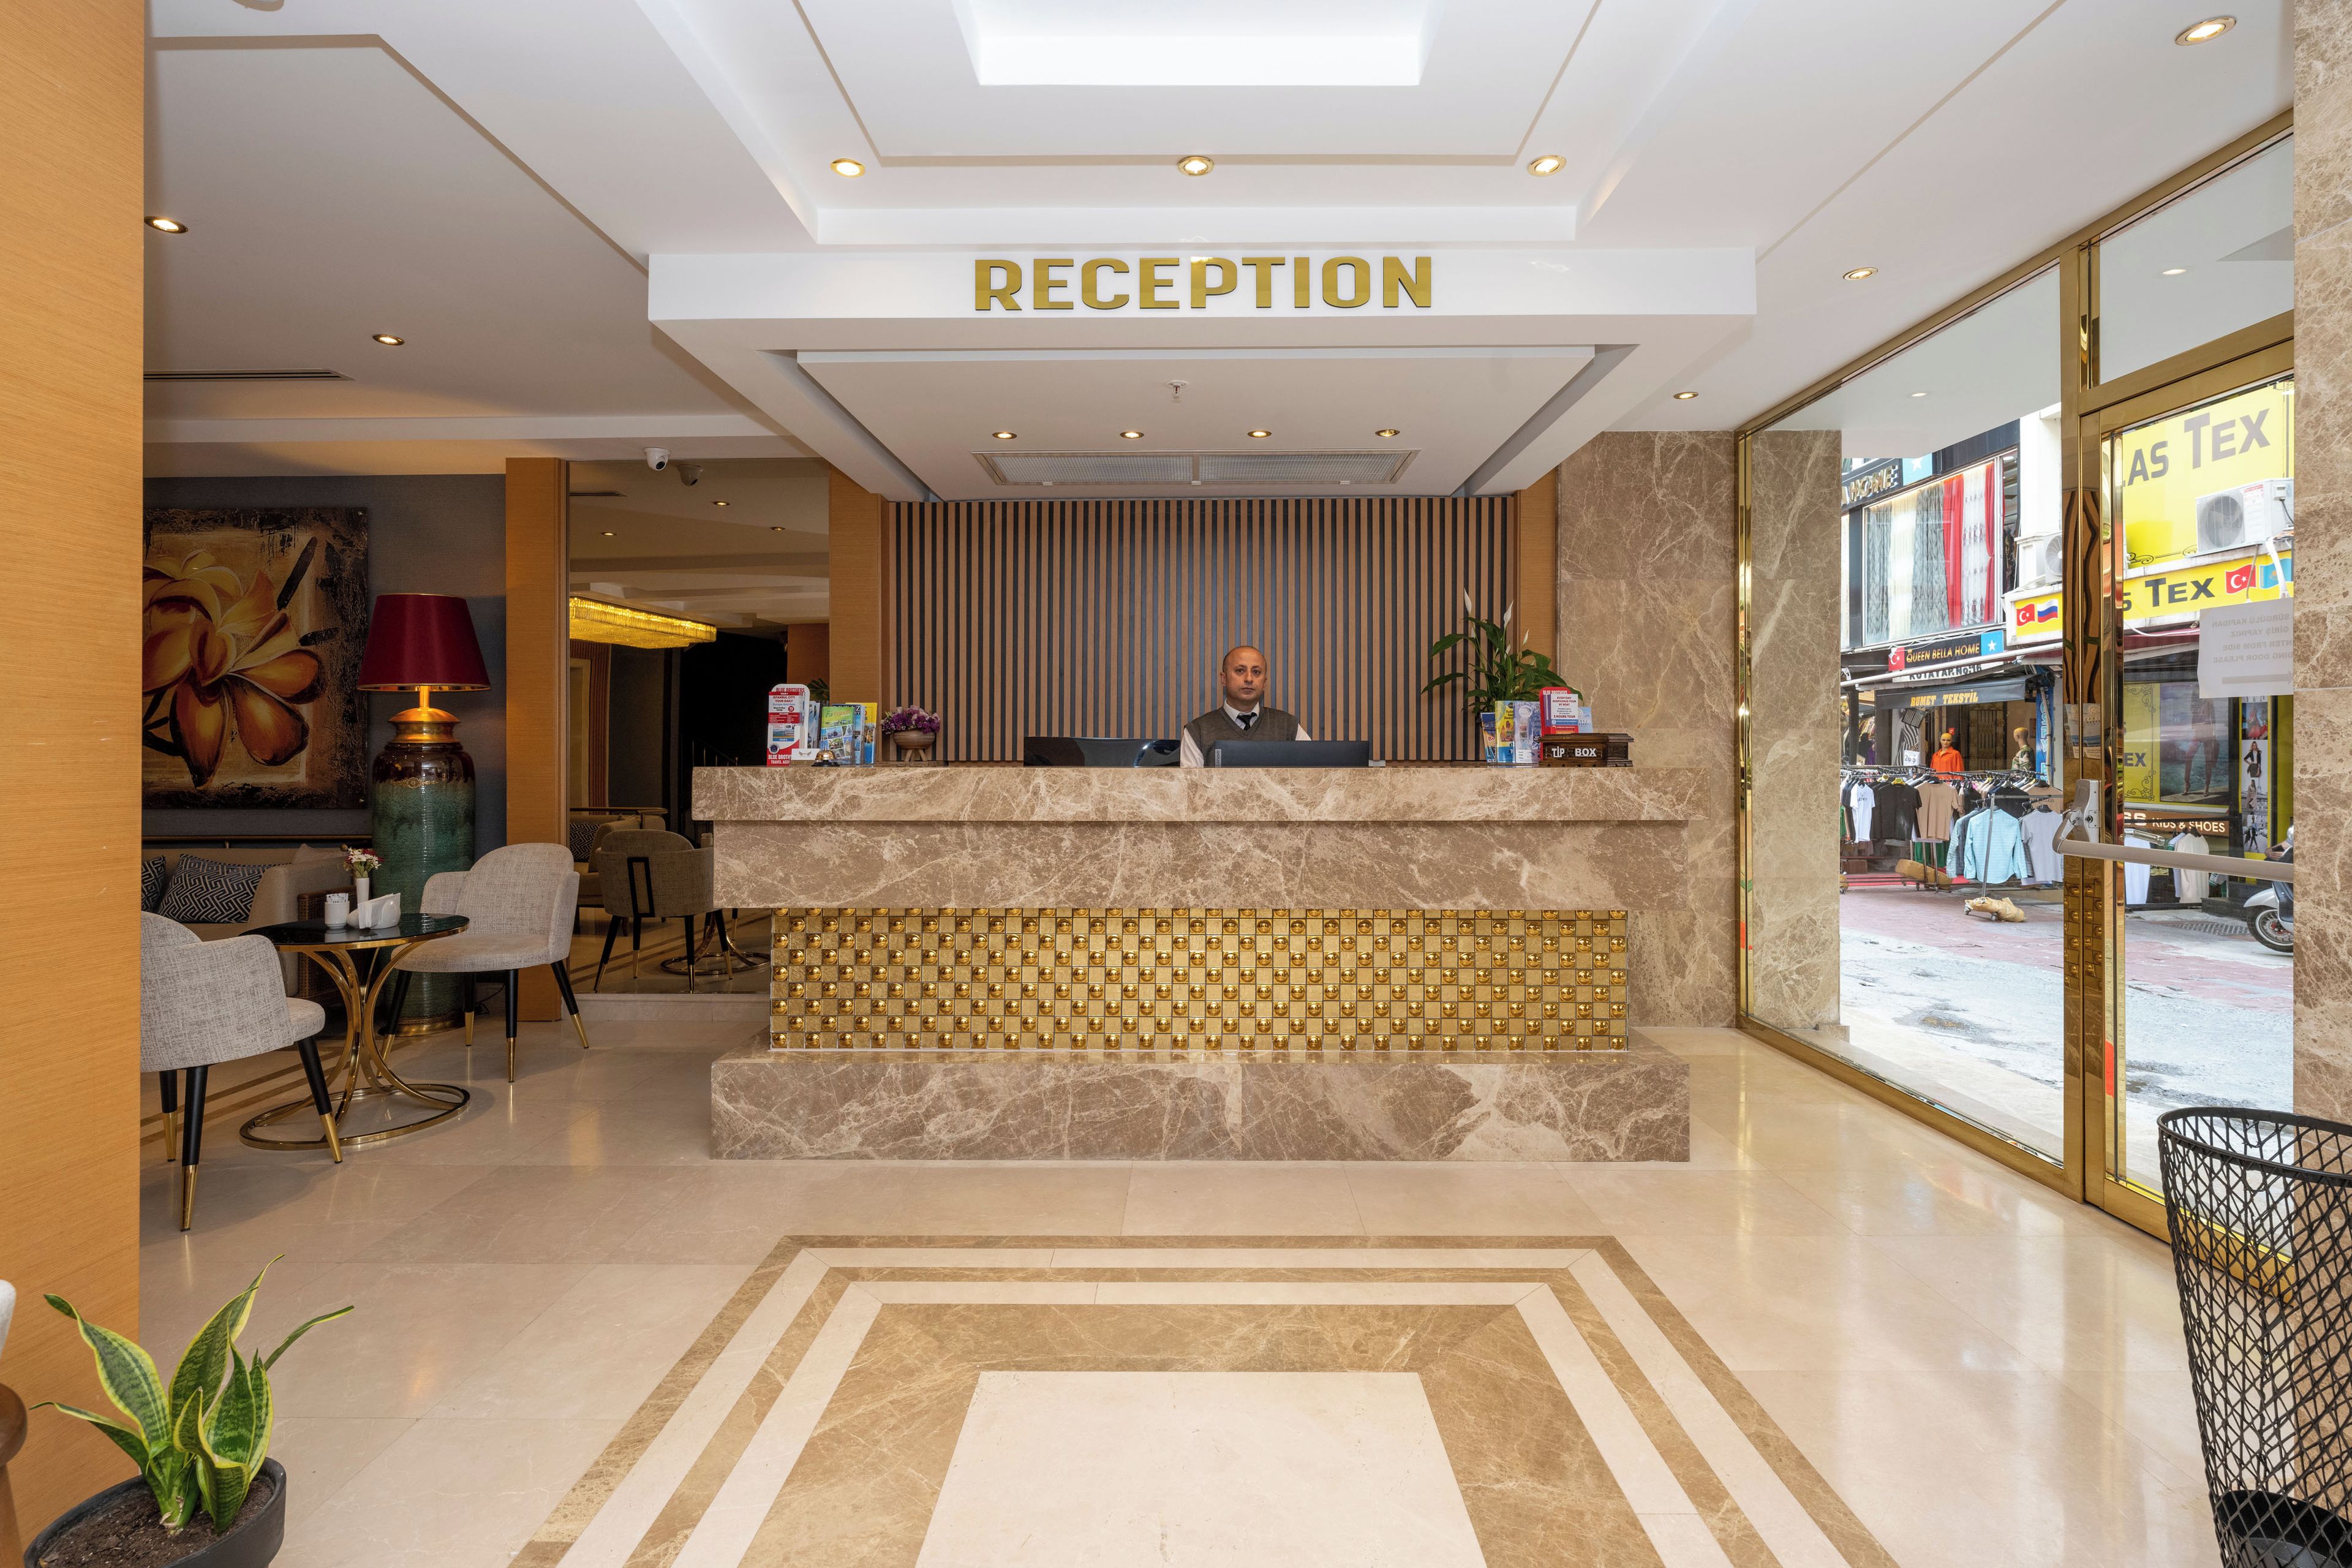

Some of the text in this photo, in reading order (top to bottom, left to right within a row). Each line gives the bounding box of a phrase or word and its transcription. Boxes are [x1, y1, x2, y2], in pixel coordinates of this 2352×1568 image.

[975, 256, 1432, 311] RECEPTION
[2122, 440, 2169, 487] AS
[1906, 643, 1980, 663] QUEEN BELLA HOME
[1942, 689, 1978, 704] TEKSTİL
[1575, 748, 1597, 757] BOX
[2124, 752, 2147, 767] EX
[2188, 821, 2225, 832] SHOES
